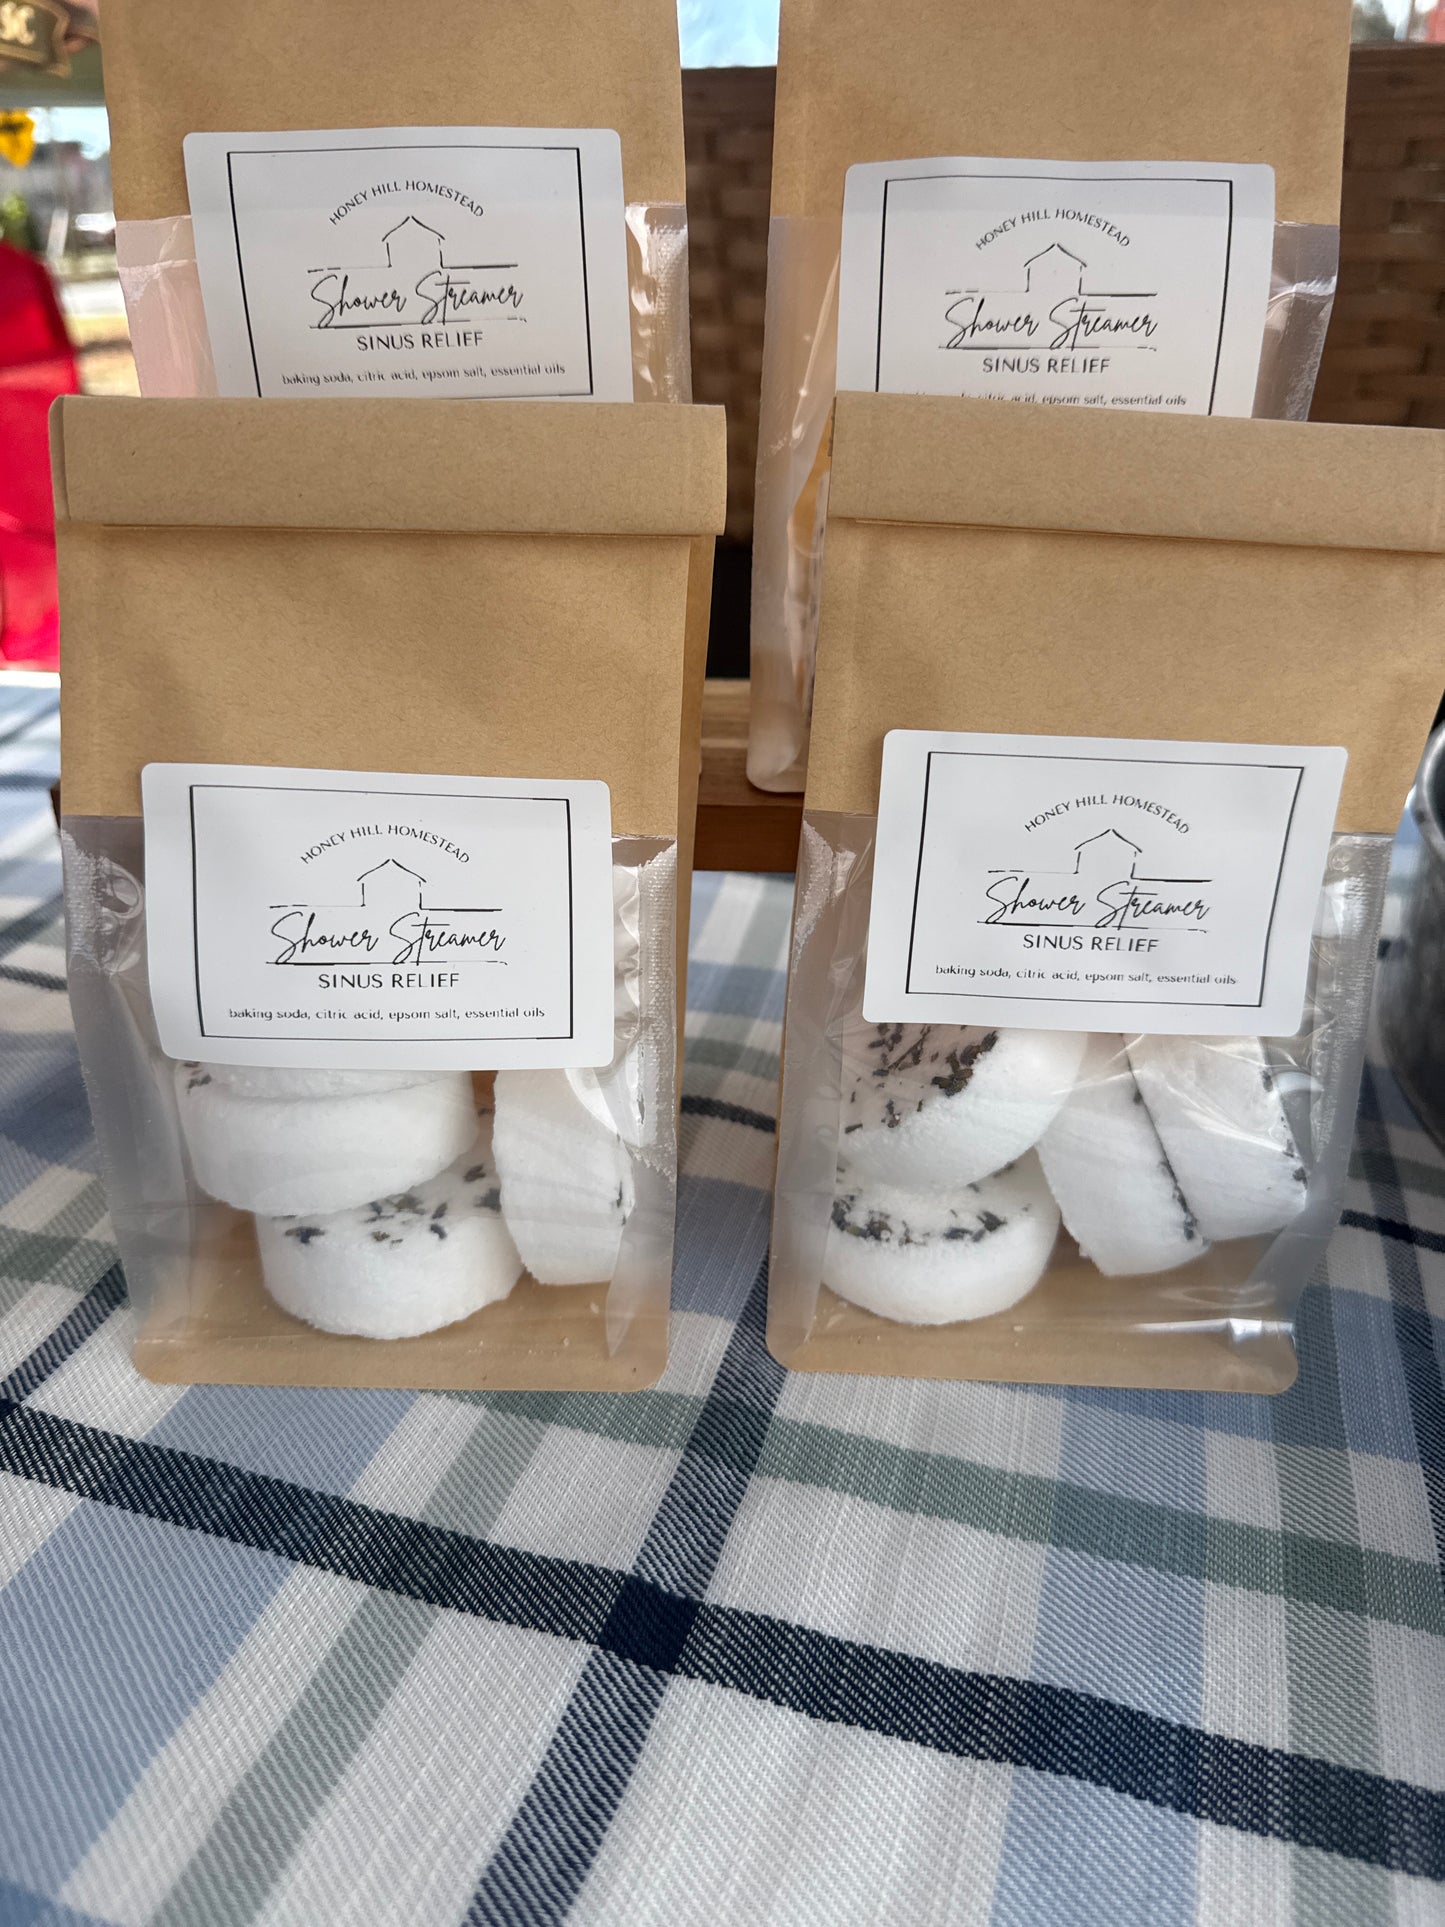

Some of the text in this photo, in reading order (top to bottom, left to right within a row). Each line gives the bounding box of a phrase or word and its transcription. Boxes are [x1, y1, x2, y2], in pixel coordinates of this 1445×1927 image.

[329, 180, 484, 226] HONEY HILL HOMESTEAD
[975, 208, 1130, 251] HONEY HILL HOMESTEAD
[310, 271, 524, 328] Shower Streamer
[945, 297, 1158, 351] Shower Streamer
[356, 331, 484, 351] SINUS RELIEF
[282, 362, 566, 387] baking soda, citric acid, epsom salt, essential oils
[982, 357, 1111, 374] SINUS RELIEF
[1083, 394, 1107, 406] salt,
[1111, 394, 1162, 405] essential
[1165, 394, 1187, 406] oils
[1024, 794, 1191, 834] HONEY HILL HOMESTEAD
[300, 824, 471, 864] HONEY HILL HOMESTEAD
[985, 876, 1211, 931] Shower Streamer
[271, 911, 507, 966] Shower Streamer
[1022, 933, 1160, 953] SINUS RELIEF
[318, 972, 460, 989] SINUS RELIEF
[935, 965, 1237, 986] baking soda, citric acid, epsom salt, essential oils
[229, 1006, 546, 1022] baking soda, citric acid, epsom salt, essential oils
